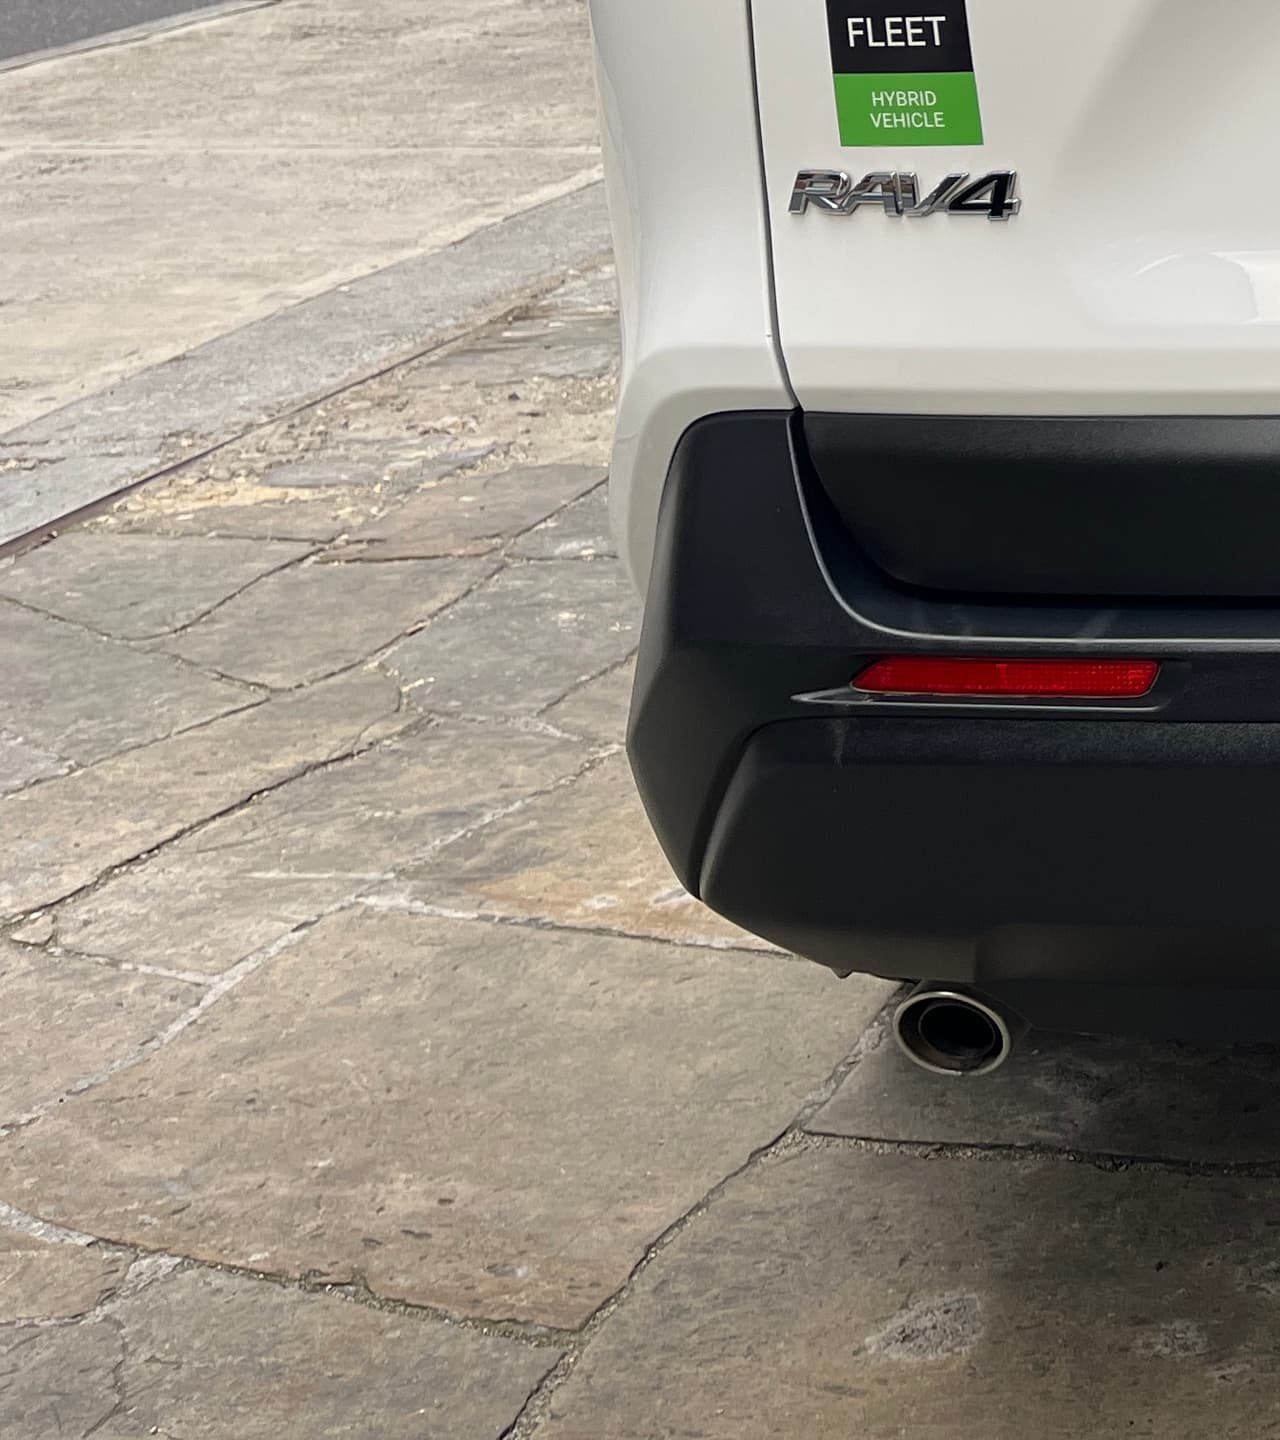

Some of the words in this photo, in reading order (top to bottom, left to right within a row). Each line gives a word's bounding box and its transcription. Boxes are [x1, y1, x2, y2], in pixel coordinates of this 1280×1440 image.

[847, 16, 946, 47] FLEET
[871, 90, 937, 107] HYBRID
[870, 112, 945, 128] VEHICLE
[788, 169, 1022, 221] RAV4
